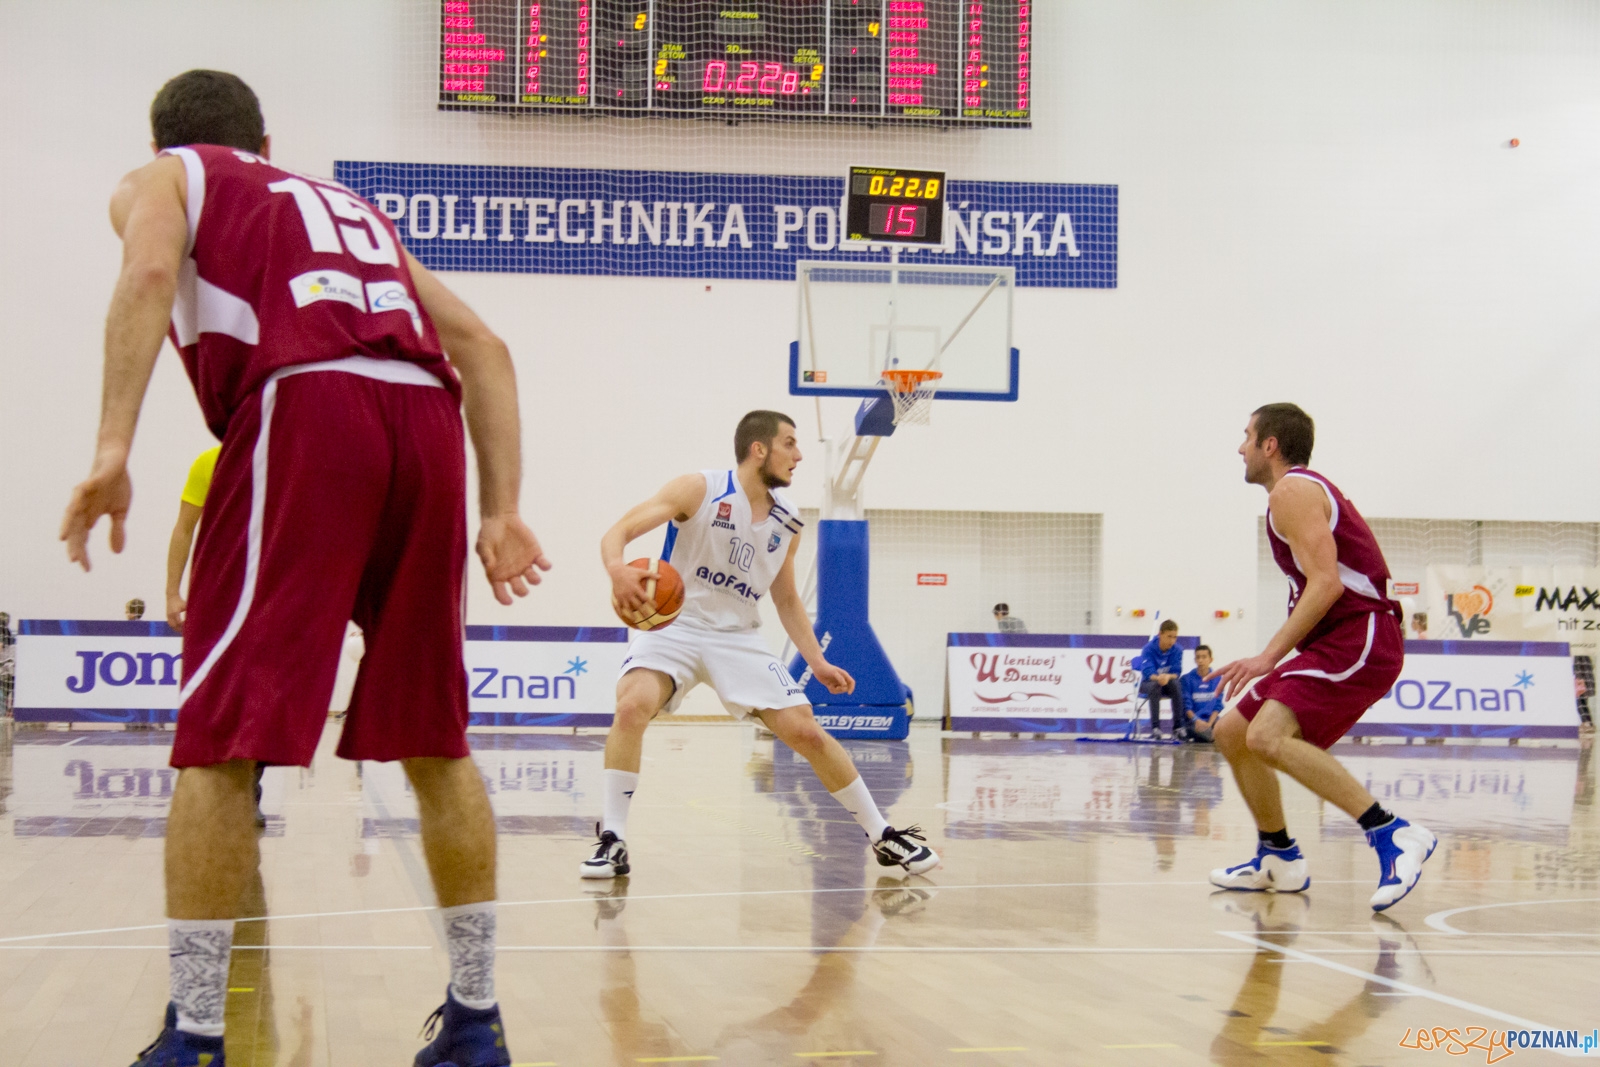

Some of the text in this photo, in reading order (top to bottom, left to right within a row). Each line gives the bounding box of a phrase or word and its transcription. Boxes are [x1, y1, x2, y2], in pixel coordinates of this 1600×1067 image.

[579, 6, 588, 18] 0
[720, 11, 760, 19] PRZERWA
[1019, 5, 1029, 18] 0
[578, 21, 588, 33] 0
[634, 13, 647, 30] 2
[1019, 21, 1028, 33] 0
[868, 22, 880, 37] 4
[578, 37, 588, 49] 0
[662, 44, 683, 52] STAN
[578, 52, 587, 63] 0
[797, 49, 818, 57] STAN
[1018, 51, 1028, 63] 0
[578, 67, 587, 79] 0
[655, 59, 668, 76] 2
[810, 64, 824, 81] 2
[577, 82, 587, 95] 0
[965, 80, 980, 92] 22
[1018, 81, 1028, 94] 0
[702, 97, 725, 105] CZAS
[734, 98, 758, 106] CZAS
[1018, 97, 1027, 110] 0
[267, 177, 400, 269] 15
[375, 193, 1080, 258] POLITECHNIKA POŃSKA
[884, 204, 918, 236] 15
[728, 537, 756, 573] 10
[1535, 585, 1600, 612] MAX
[1003, 653, 1055, 669] leniwej
[66, 651, 183, 693] Jom
[1003, 667, 1062, 685] Danuty
[467, 666, 576, 700] Znan
[814, 715, 894, 731] ORTSYSTEM
